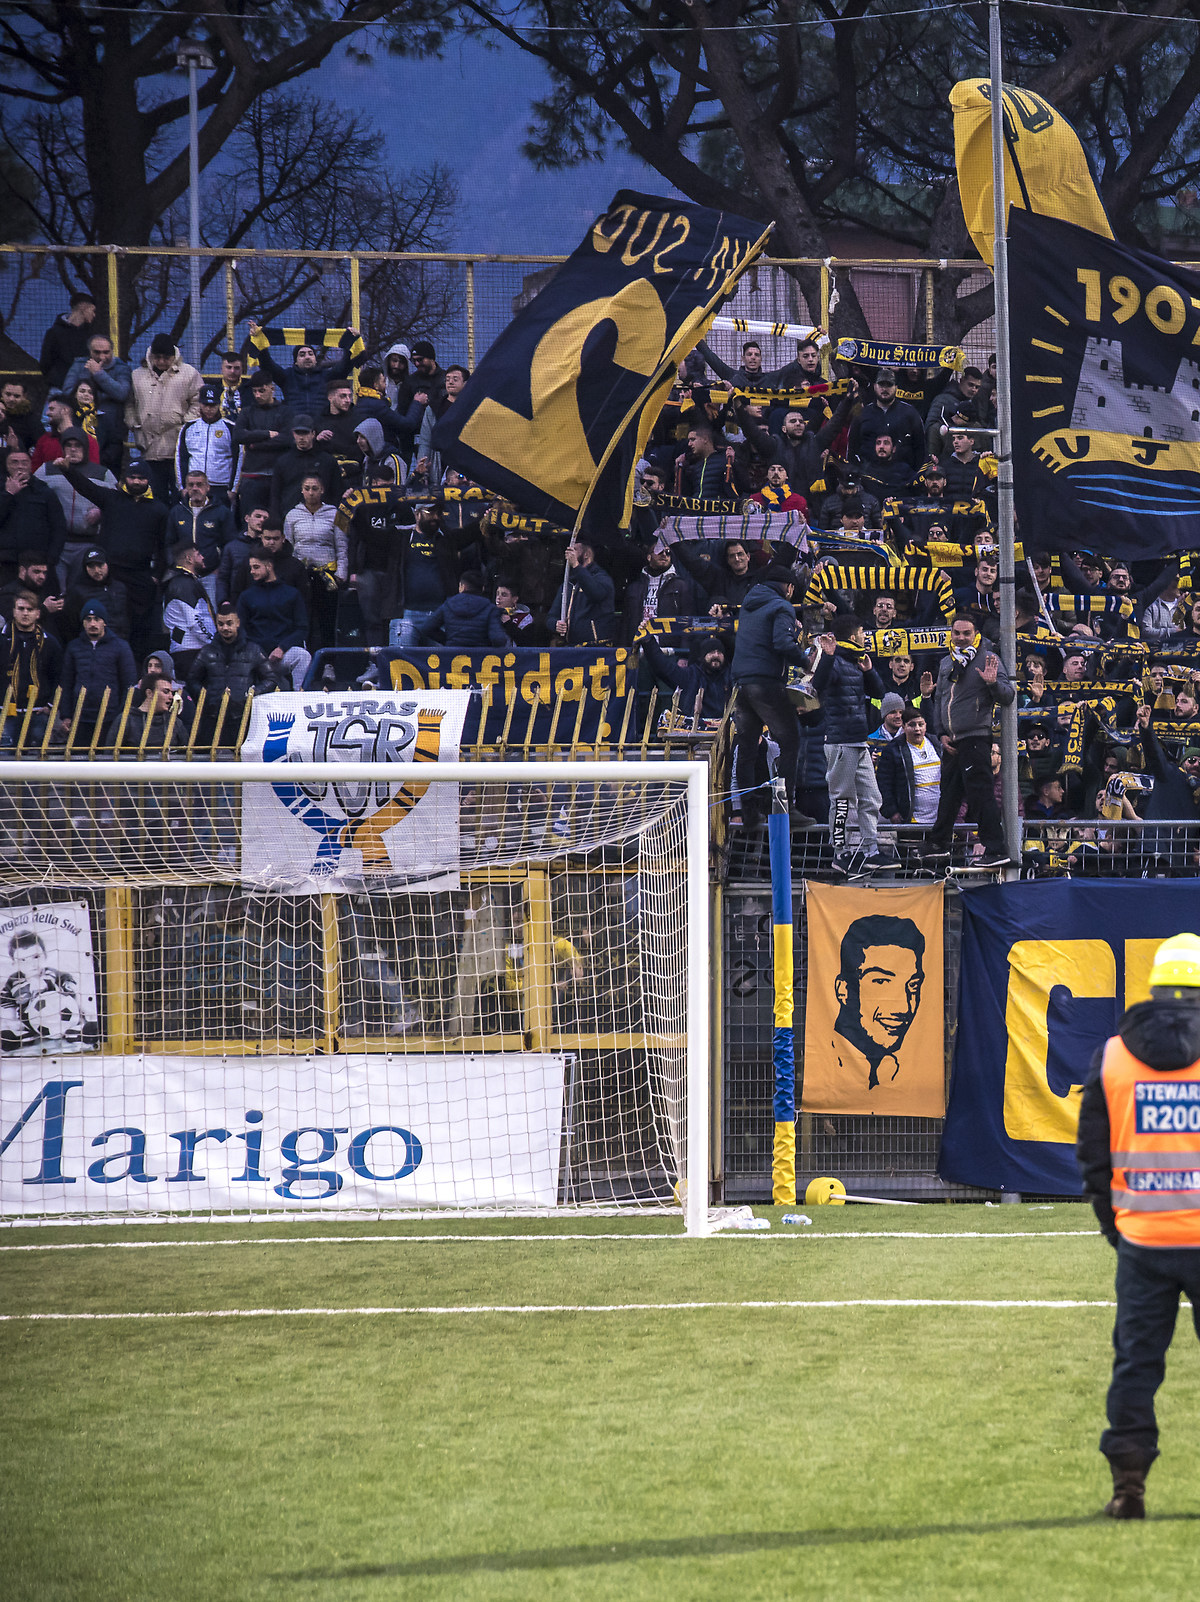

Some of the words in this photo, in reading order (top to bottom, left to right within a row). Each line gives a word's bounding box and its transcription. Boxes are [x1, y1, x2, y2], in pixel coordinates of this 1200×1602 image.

[859, 341, 891, 361] Juve
[893, 345, 937, 362] Stabia
[656, 494, 736, 513] STABIESI
[390, 647, 627, 706] Diffidati
[303, 699, 418, 719] ULTRAS
[1064, 754, 1081, 764] 1907
[836, 799, 848, 825] NIKE
[0, 915, 29, 935] ngelo
[32, 912, 59, 925] della
